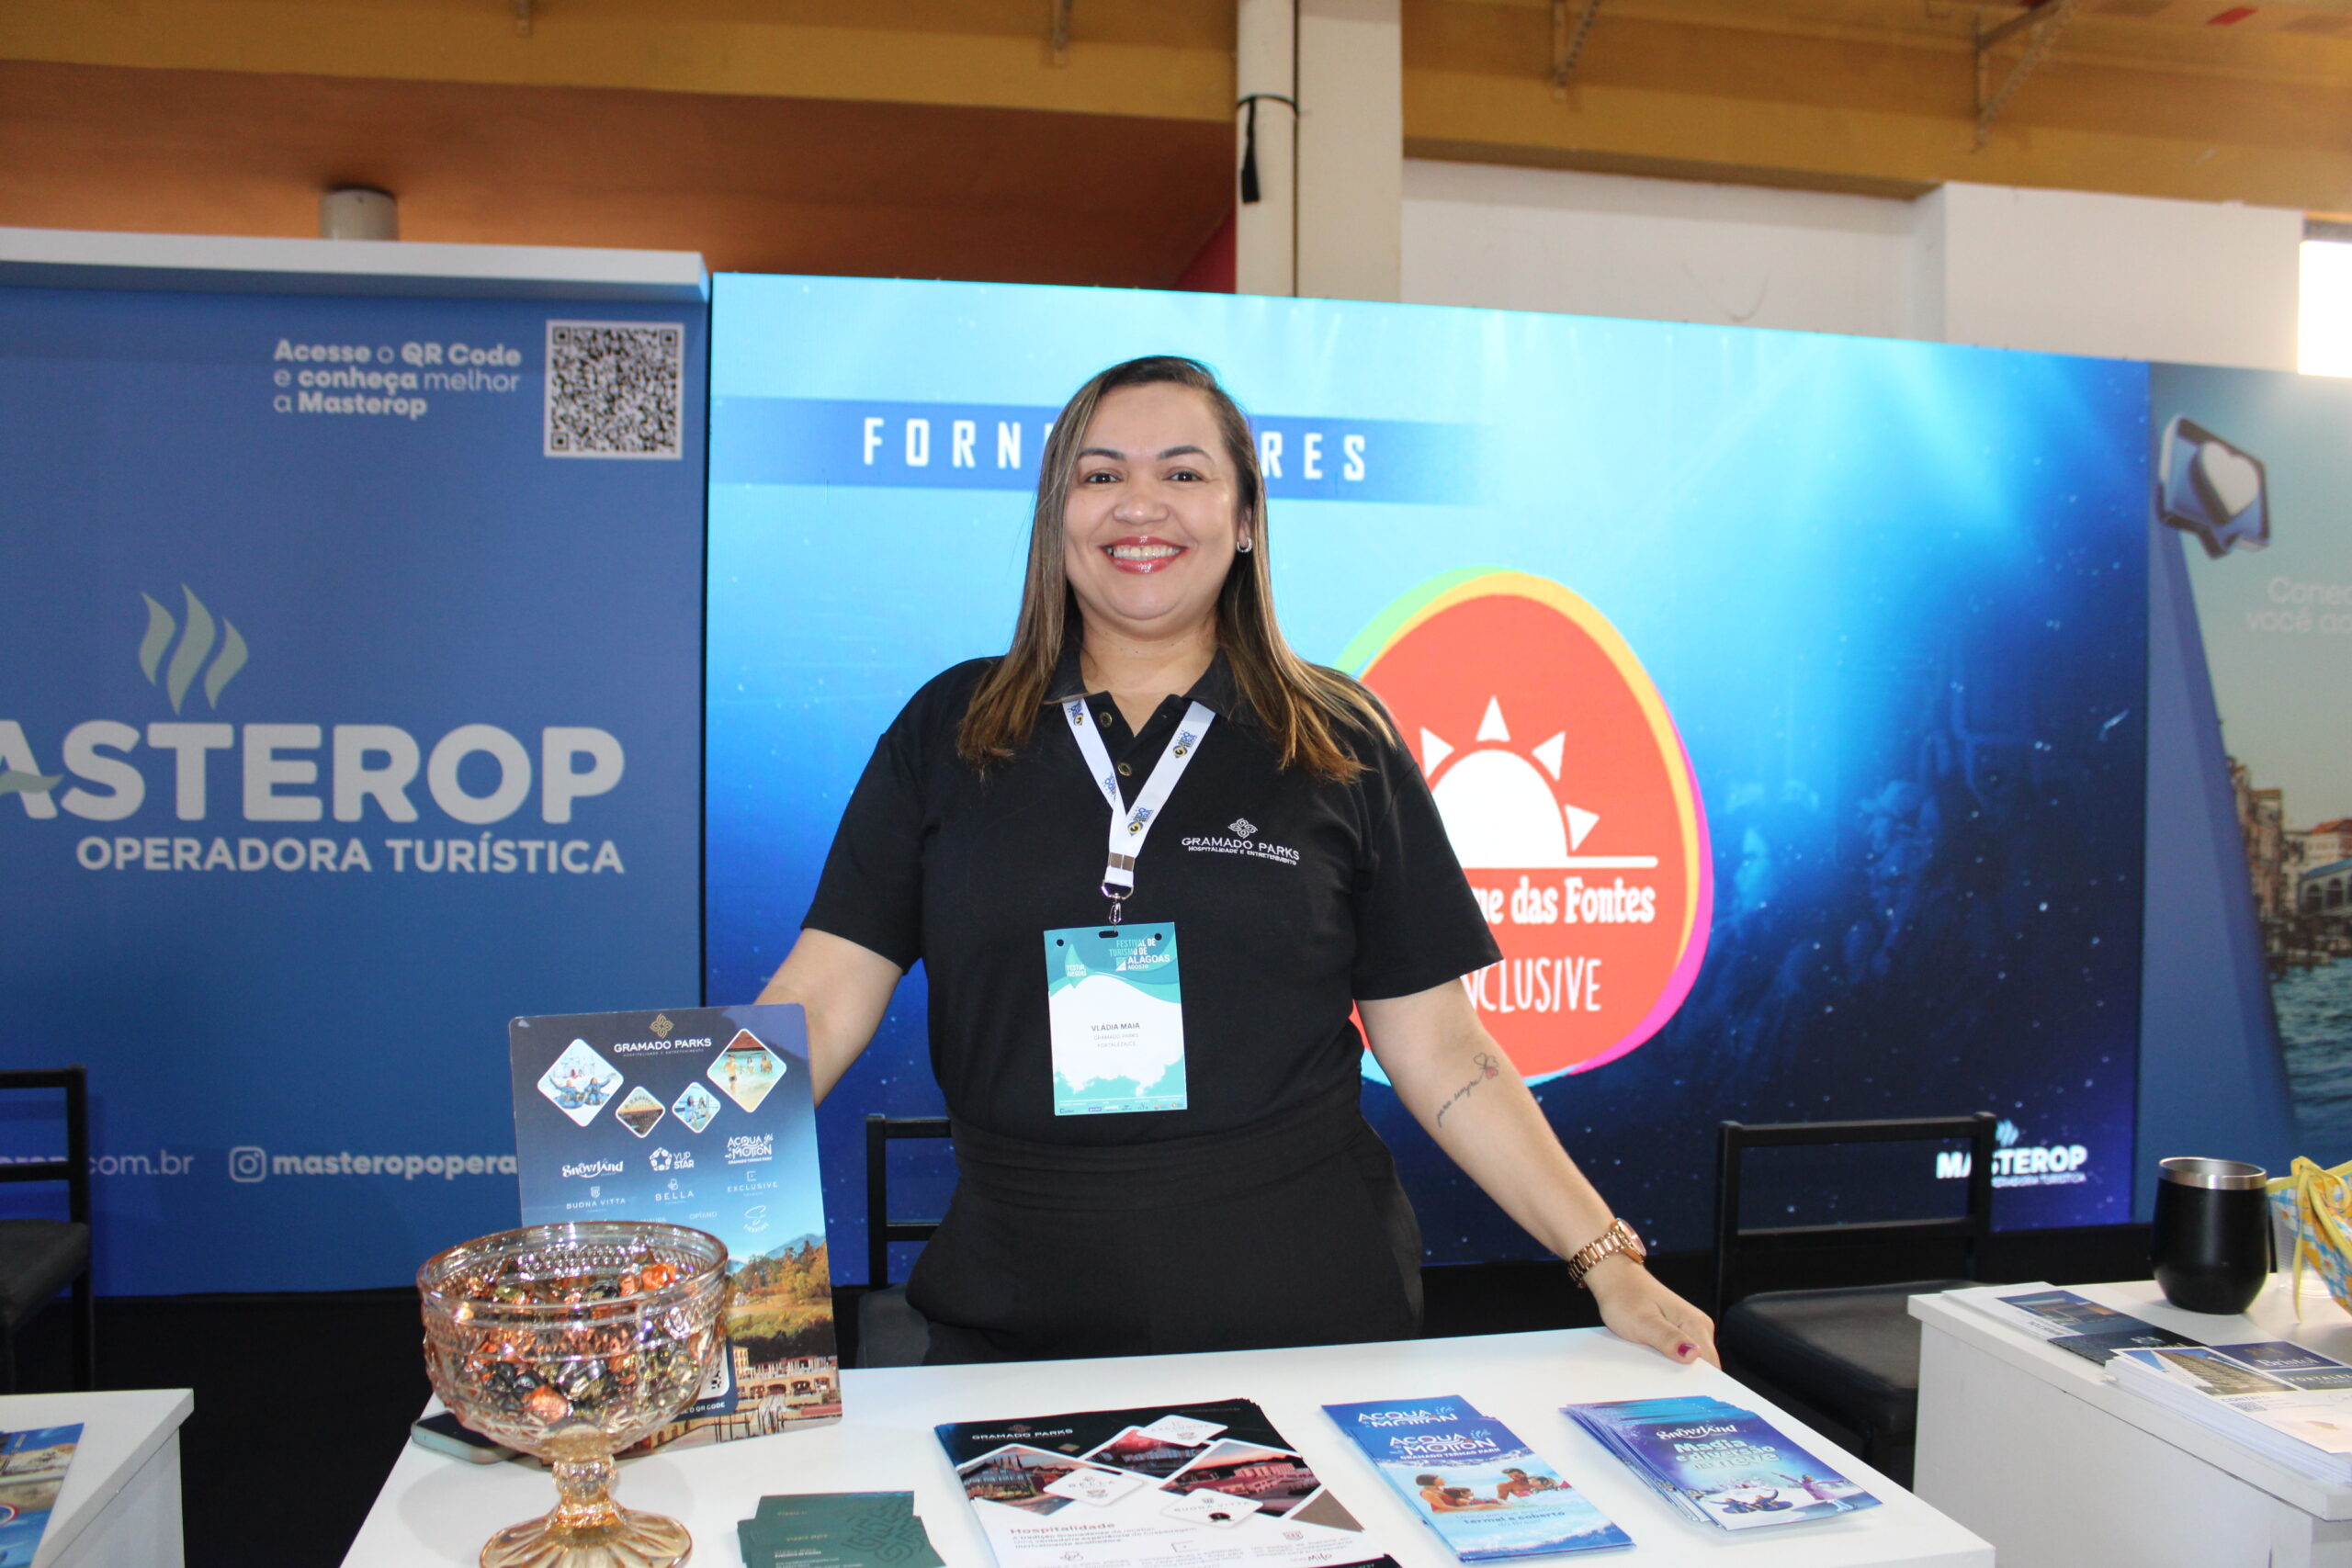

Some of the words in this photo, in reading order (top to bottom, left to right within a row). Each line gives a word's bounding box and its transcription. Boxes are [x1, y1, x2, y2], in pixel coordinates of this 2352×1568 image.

[273, 338, 371, 363] Acesse
[377, 345, 395, 365] o
[401, 342, 443, 367] QR
[447, 343, 522, 367] Code
[274, 368, 291, 388] e
[298, 365, 418, 397] conheça
[424, 368, 522, 392] melhor
[273, 394, 292, 413] a
[298, 390, 428, 421] Masterop
[76, 836, 372, 872] OPERADORA
[386, 831, 626, 874] TURÍSTICA
[1181, 837, 1254, 850] GRAMADO
[1258, 842, 1300, 861] PARKS
[1510, 874, 1559, 925] das
[1564, 875, 1657, 924] Fontes
[1115, 939, 1146, 948] FESTIVAL
[1147, 938, 1157, 947] DE
[1109, 947, 1138, 957] TURISMO
[1139, 946, 1148, 956] DE
[1126, 953, 1171, 964] ALAGOAS
[1120, 1021, 1140, 1030] MAIA
[613, 1040, 672, 1054] GRAMADO
[674, 1037, 712, 1049] PARKS
[727, 1135, 763, 1148] ACQUA
[731, 1144, 773, 1159] MOTION
[673, 1159, 695, 1170] STAR
[727, 1181, 778, 1193] EXCLUSIVE
[655, 1190, 695, 1202] BELLA
[566, 1201, 597, 1210] BUONA
[600, 1198, 626, 1206] VITTA
[707, 1401, 726, 1411] CODE
[1358, 1409, 1433, 1423] ACQUA
[971, 1432, 1031, 1440] GRAMADO
[1034, 1427, 1074, 1438] PARKS
[1656, 1424, 1738, 1439] Snowland
[1389, 1432, 1468, 1447] ACQUA
[1402, 1437, 1498, 1456] MOTION
[1673, 1438, 1748, 1453] Magia
[1675, 1454, 1689, 1462] e
[1690, 1445, 1776, 1461] diversão
[1719, 1452, 1780, 1468] neve
[1010, 1522, 1115, 1535] Hospitalidade
